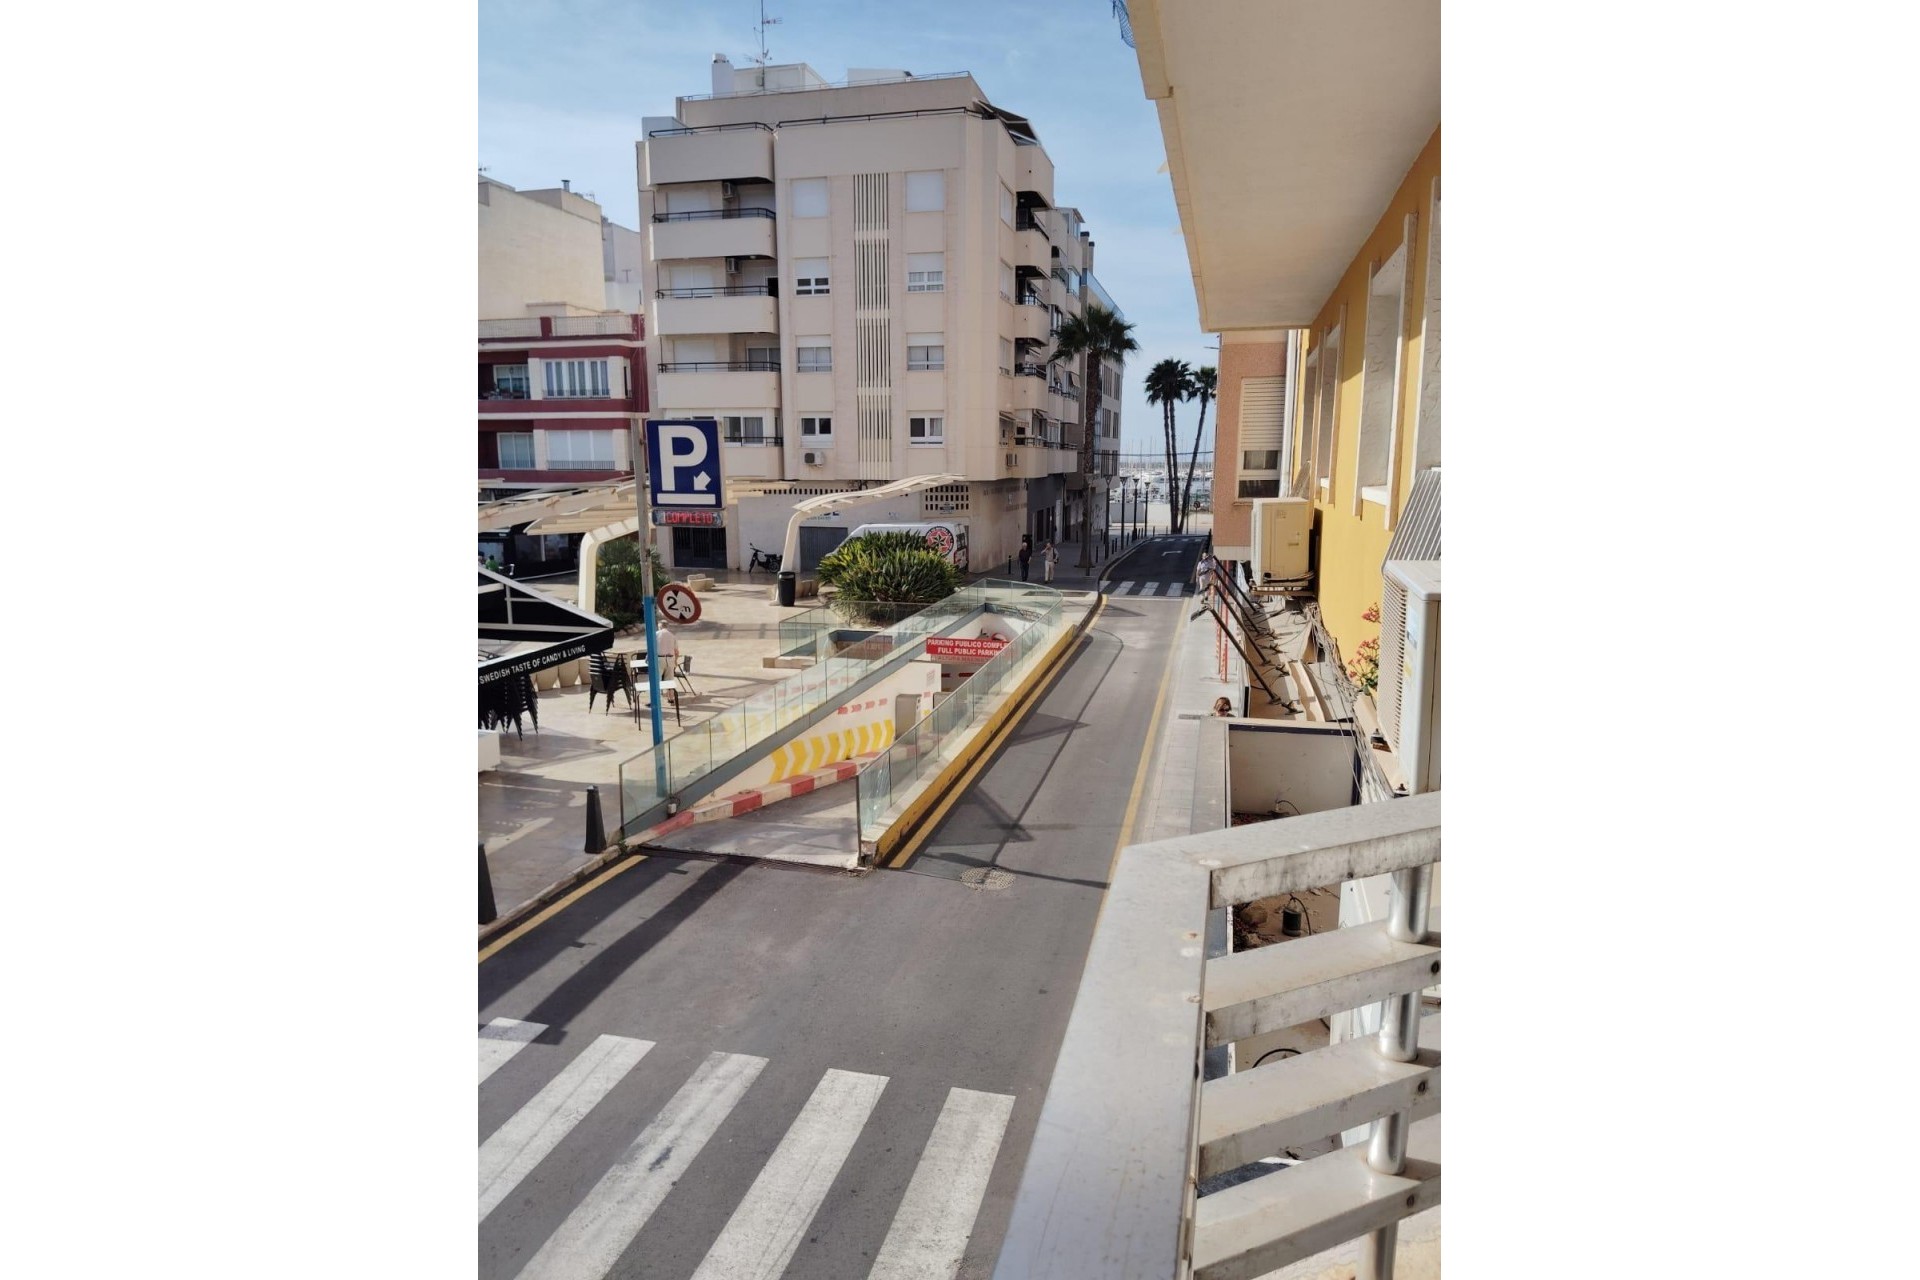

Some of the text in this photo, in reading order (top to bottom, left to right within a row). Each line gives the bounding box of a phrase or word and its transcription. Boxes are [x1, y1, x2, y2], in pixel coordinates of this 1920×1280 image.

[658, 425, 708, 491] P
[665, 511, 713, 524] COMPLETO
[927, 638, 954, 647] PARKING
[479, 669, 511, 685] SWEDISH
[511, 661, 531, 674] TASTE
[532, 658, 541, 667] OF
[541, 652, 562, 665] CANDY
[567, 644, 586, 656] LIVING
